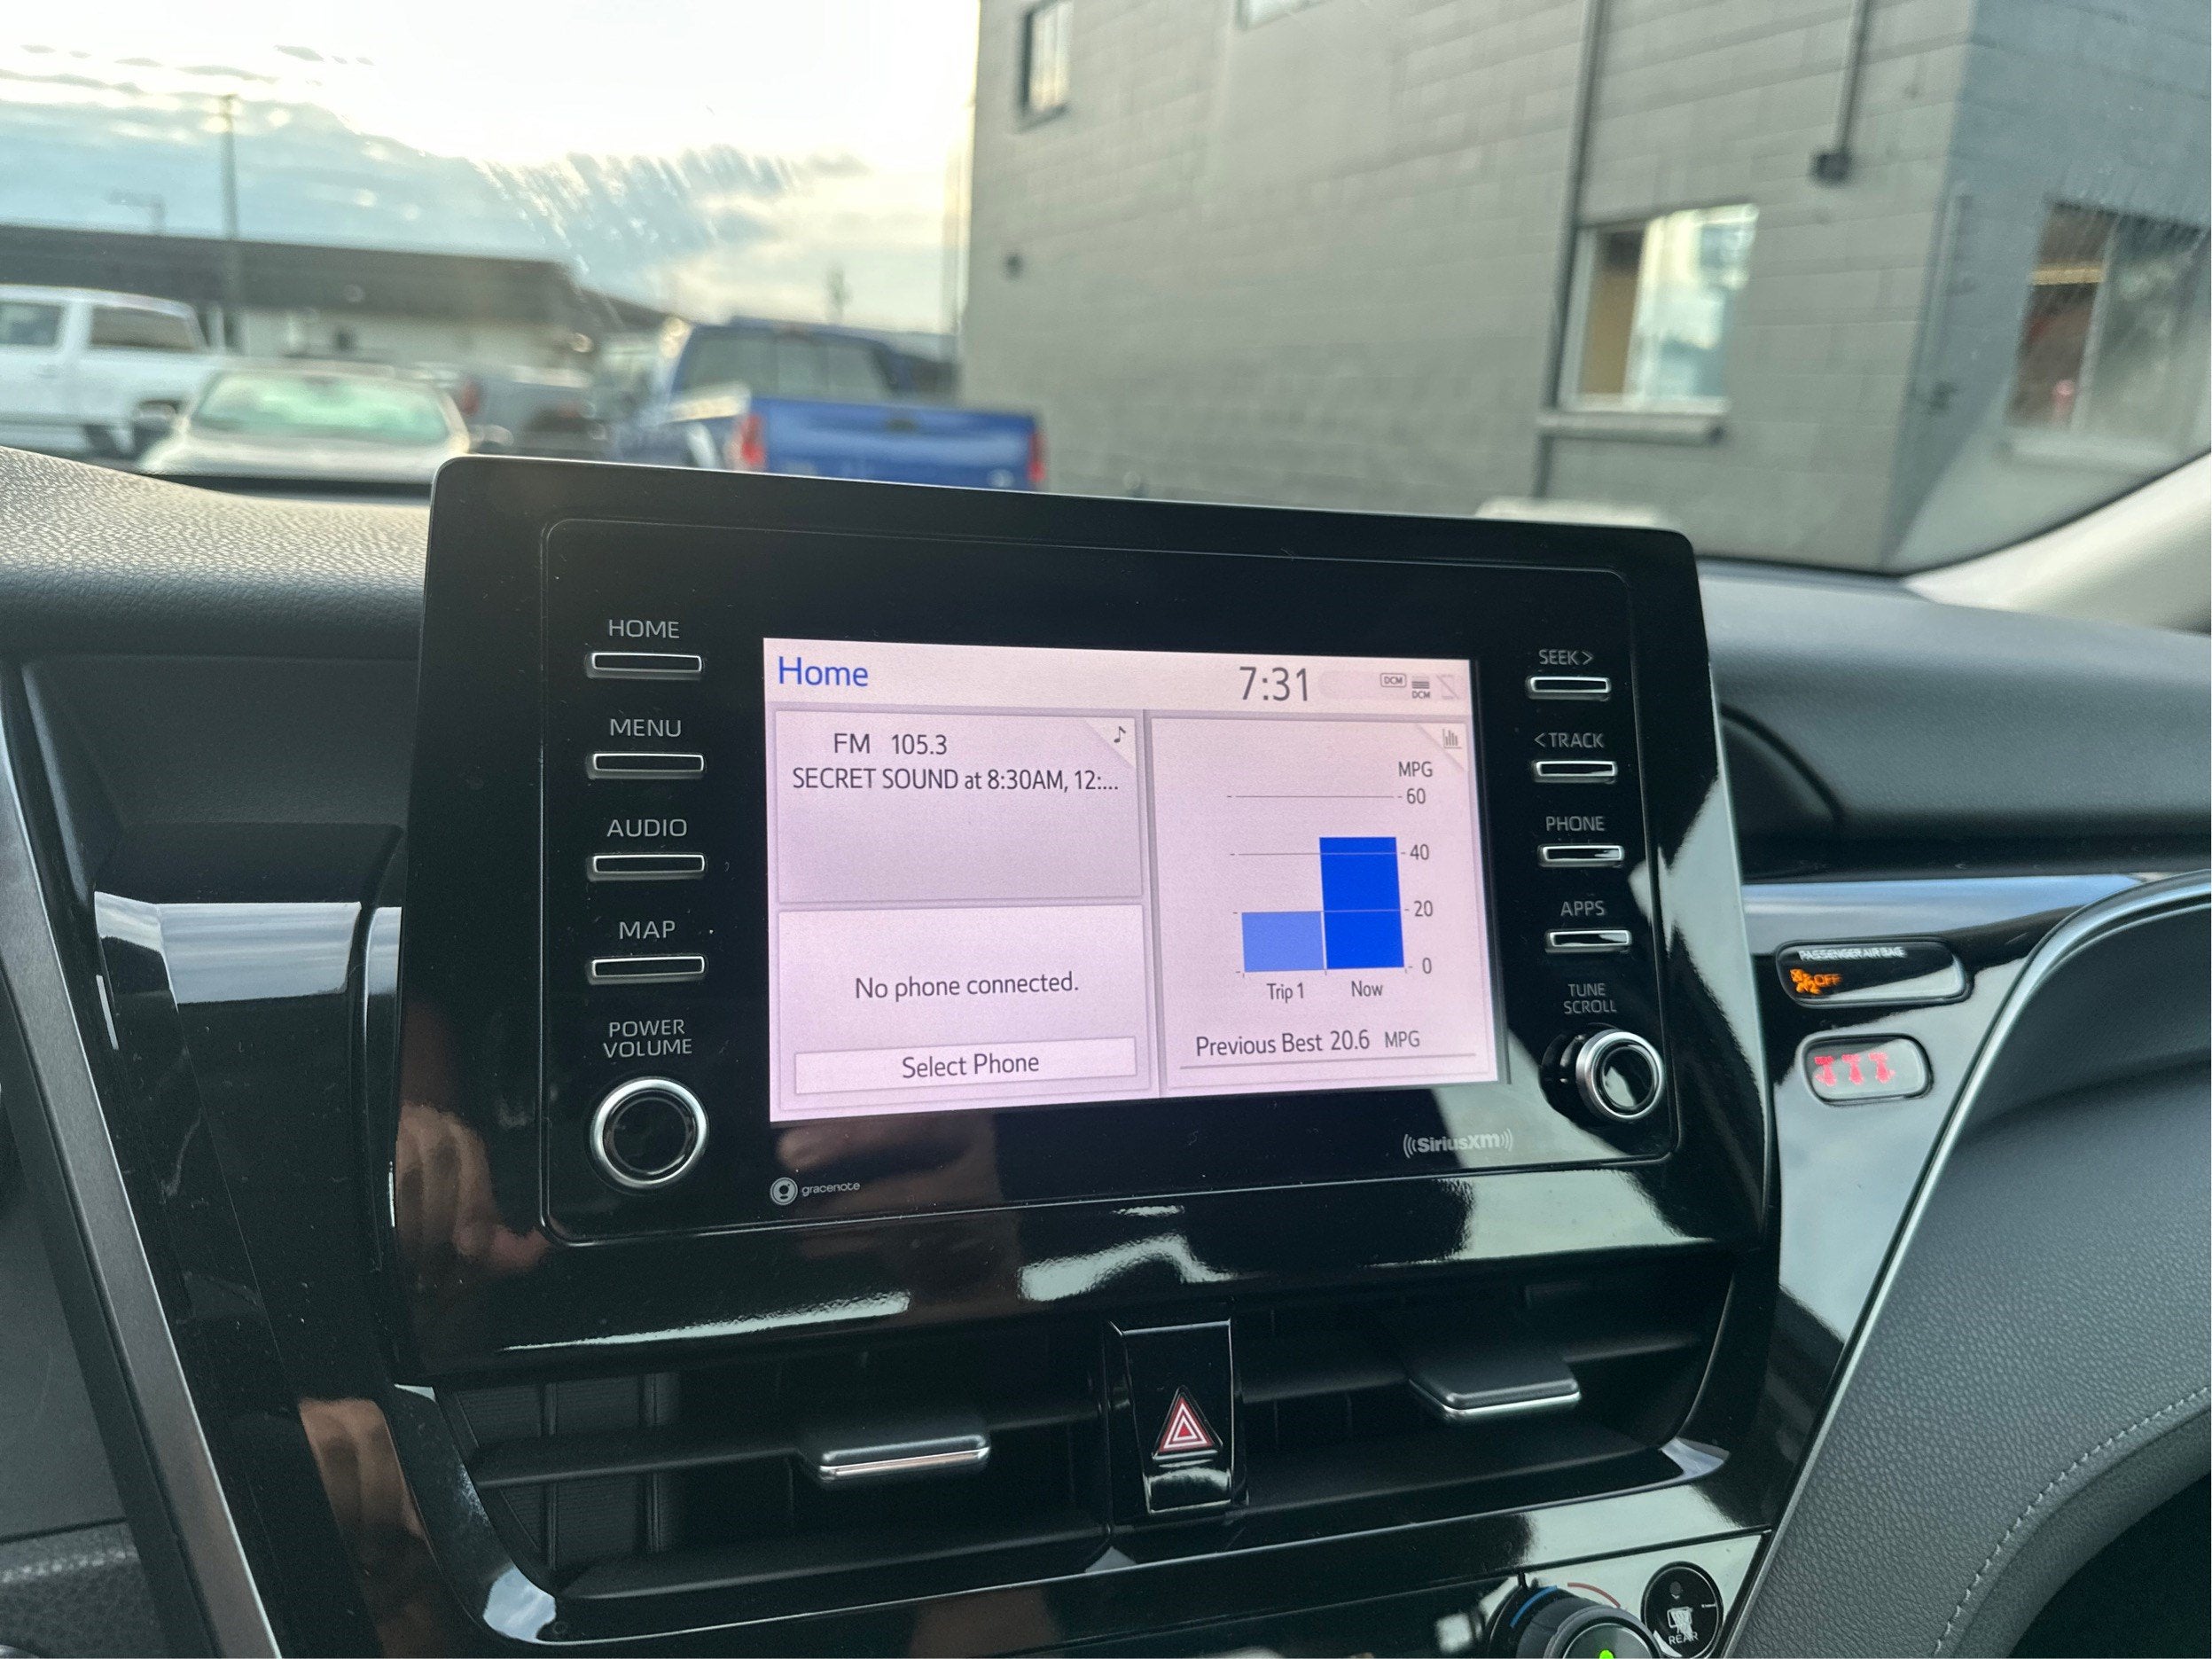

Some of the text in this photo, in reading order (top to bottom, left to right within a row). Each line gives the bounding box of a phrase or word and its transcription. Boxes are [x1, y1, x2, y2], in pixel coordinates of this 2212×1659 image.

[607, 619, 680, 639] HOME
[778, 656, 869, 687] Home
[1239, 666, 1310, 701] 7:31
[610, 718, 682, 738] MENU
[833, 733, 948, 755] FM 105.3
[1398, 762, 1434, 778] MPG
[793, 768, 876, 789] SECRET
[882, 769, 958, 790] SOUND
[965, 772, 982, 790] at
[987, 770, 1068, 794] 8:30AM,
[1406, 788, 1426, 805] 60
[606, 818, 688, 838] AUDIO
[1545, 816, 1606, 832] PHONE
[1410, 843, 1430, 861] 40
[1413, 900, 1434, 917] 20
[1560, 900, 1606, 917] APPS
[619, 920, 676, 940] MAP
[1422, 958, 1433, 974] 0
[855, 970, 1080, 1002] No phone connected.
[1267, 982, 1305, 1003] Trip 1
[1351, 980, 1384, 998] Now
[1568, 982, 1606, 997] TUNE
[1563, 999, 1617, 1014] SCROLL
[608, 1020, 685, 1037] POWER
[603, 1038, 692, 1059] VOLUME
[1195, 1029, 1420, 1057] Previous Best 20.6 MPG
[902, 1053, 1040, 1079] Select Phone
[801, 1182, 861, 1197] gracenote
[1669, 1632, 1699, 1645] REAR
